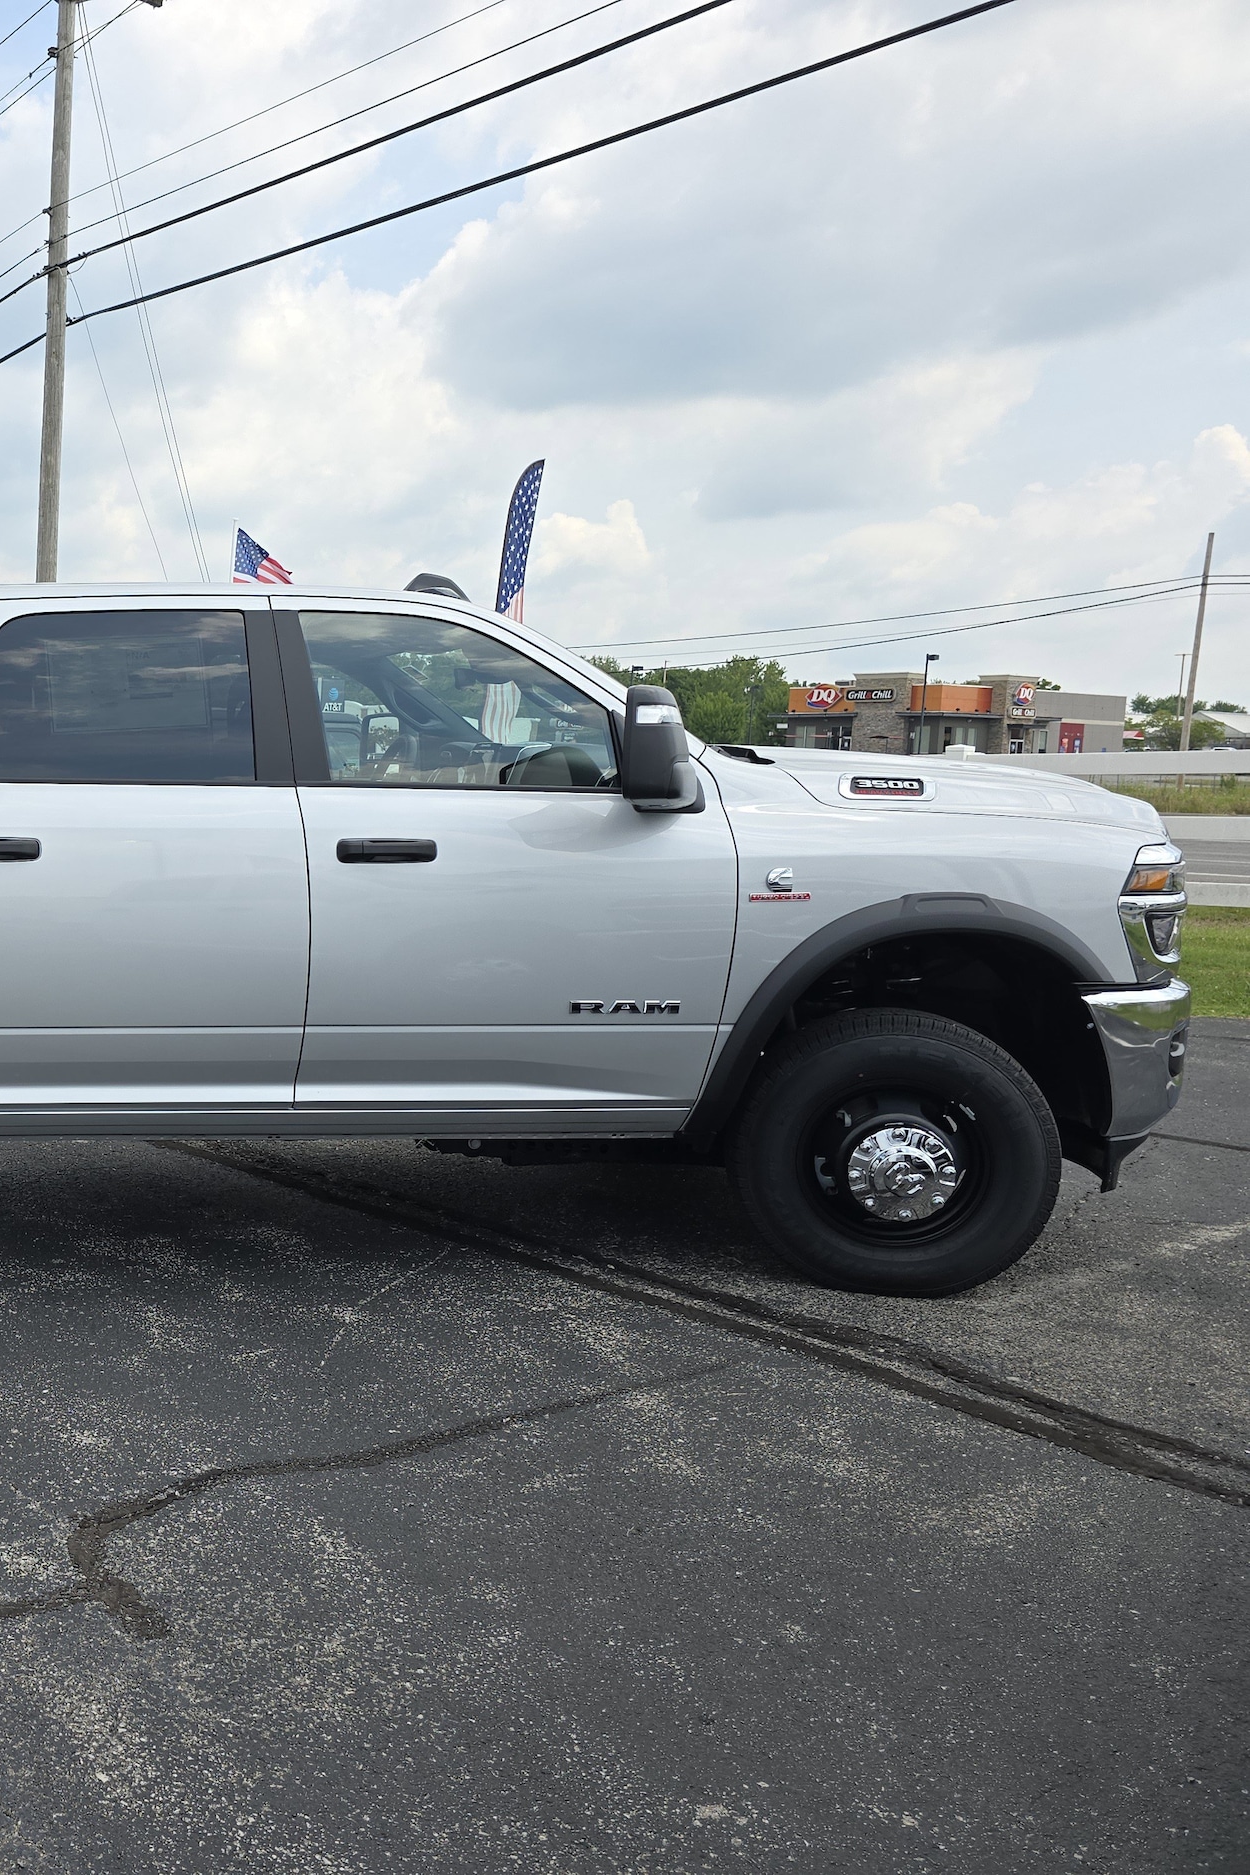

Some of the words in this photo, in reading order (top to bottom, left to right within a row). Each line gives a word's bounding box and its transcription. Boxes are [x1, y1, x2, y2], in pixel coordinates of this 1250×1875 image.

[812, 688, 836, 704] DQ
[848, 690, 867, 699] Grill
[871, 689, 893, 699] Chill
[1019, 687, 1034, 701] DQ
[323, 702, 343, 712] AT&T
[854, 779, 920, 789] 3500
[569, 1000, 681, 1015] RAM
